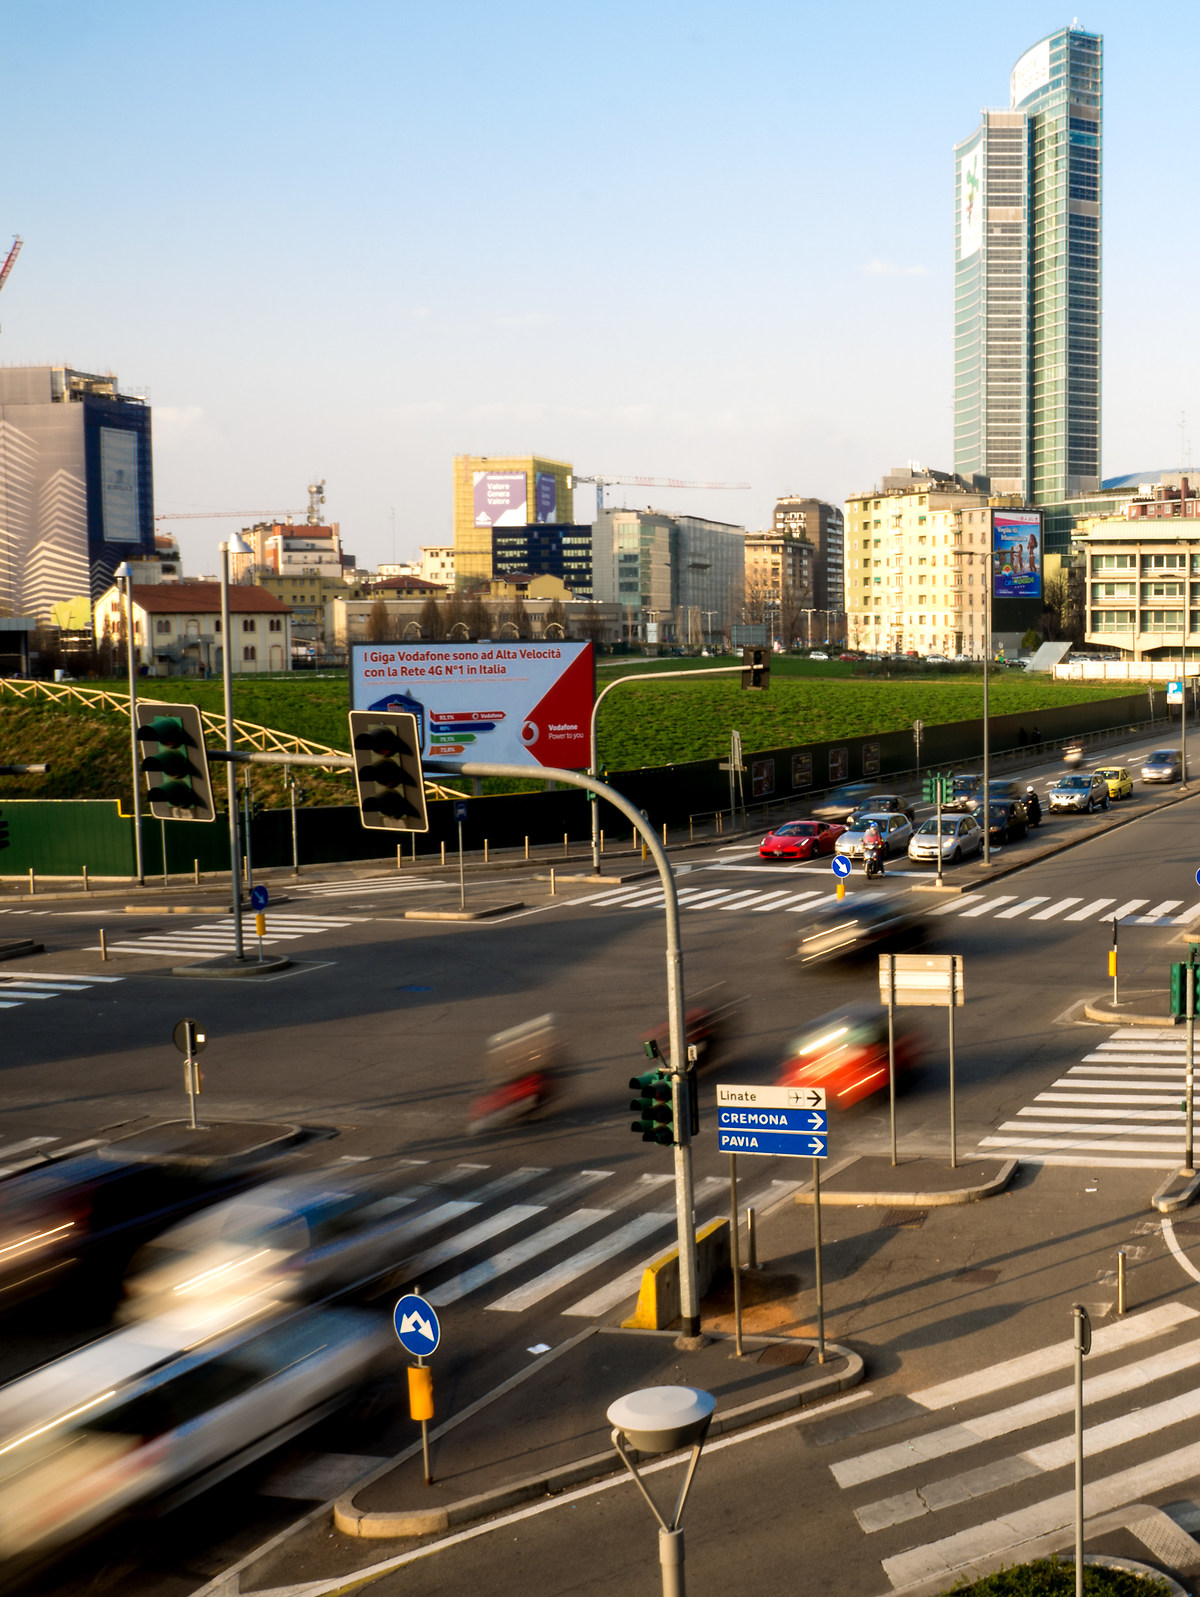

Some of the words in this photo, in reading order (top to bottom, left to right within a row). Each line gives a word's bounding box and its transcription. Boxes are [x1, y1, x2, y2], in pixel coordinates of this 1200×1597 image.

[364, 651, 367, 662] I
[370, 651, 395, 665] Giga
[398, 650, 450, 662] Vodafone
[452, 652, 478, 661] sono
[480, 649, 493, 660] ad
[495, 649, 517, 660] Alta
[519, 648, 561, 659] Velocità
[364, 668, 385, 678] con
[387, 666, 398, 677] la
[400, 666, 425, 677] Rete
[428, 665, 443, 676] 4G
[445, 664, 463, 675] N°1
[467, 664, 477, 675] in
[480, 663, 506, 674] Italia
[548, 723, 578, 731] Vodafone
[548, 732, 565, 740] Power
[720, 1090, 757, 1102] Linate
[721, 1112, 788, 1125] CREMONA
[721, 1135, 759, 1148] PAVIA
